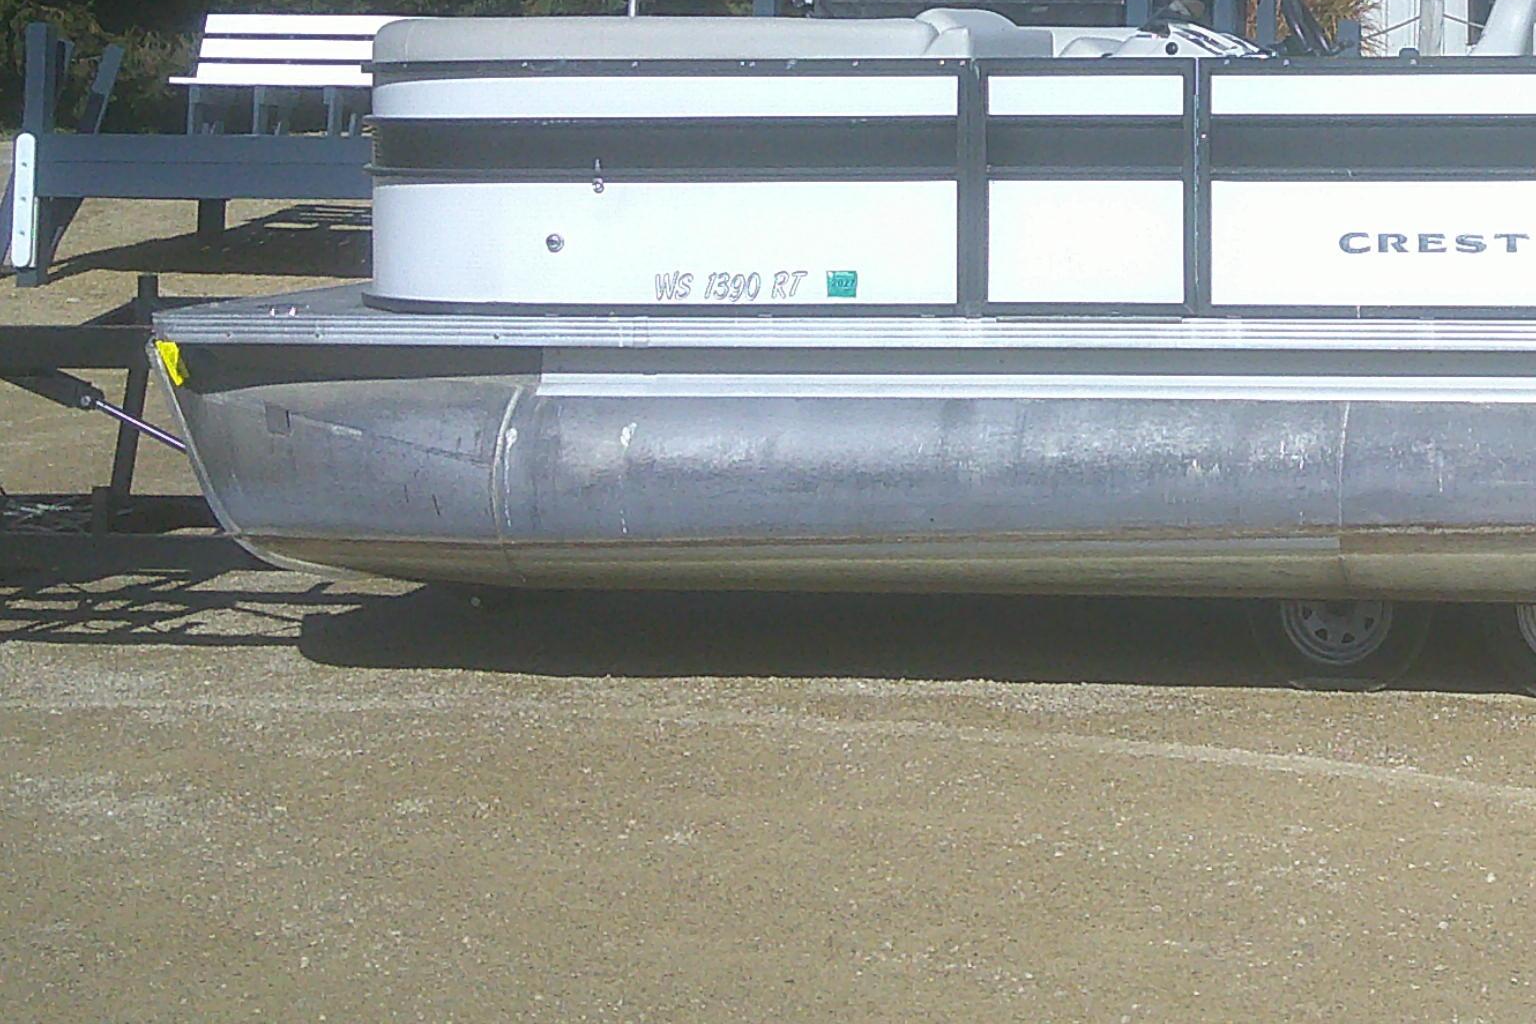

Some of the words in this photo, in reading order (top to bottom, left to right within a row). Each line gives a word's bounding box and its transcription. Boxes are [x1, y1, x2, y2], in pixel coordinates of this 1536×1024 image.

[1339, 232, 1530, 254] CREST
[655, 271, 694, 301] WS
[704, 272, 761, 302] 1390
[771, 271, 808, 299] RT
